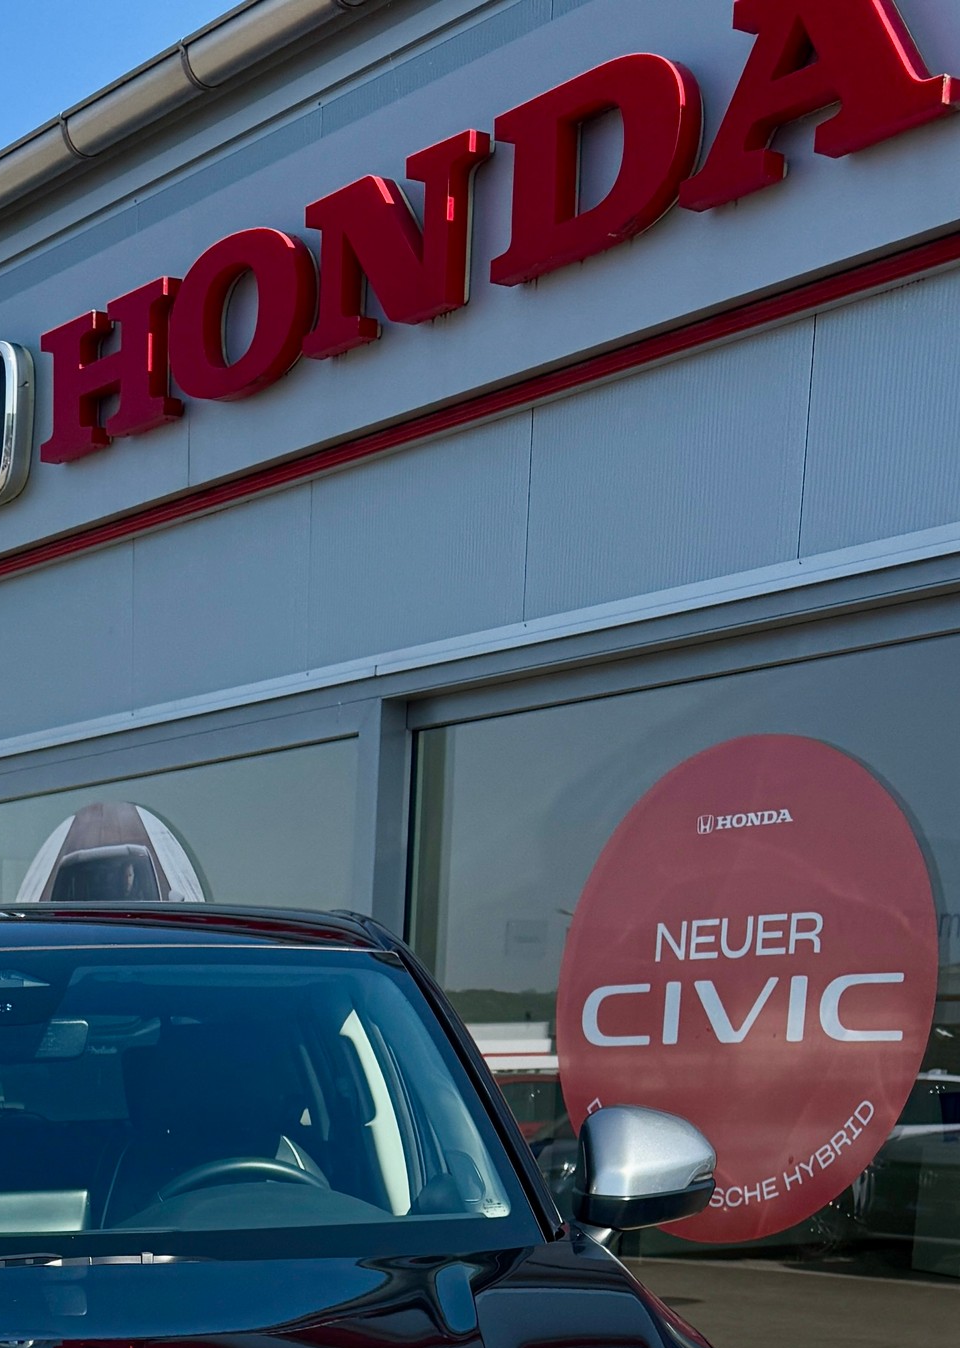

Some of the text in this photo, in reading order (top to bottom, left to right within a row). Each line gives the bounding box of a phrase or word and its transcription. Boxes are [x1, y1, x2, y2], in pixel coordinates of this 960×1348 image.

[41, 0, 960, 463] HONDA
[715, 808, 793, 830] HONDA
[654, 911, 823, 962] NEUER
[581, 972, 905, 1047] CIVIC
[708, 1099, 875, 1208] SCHE HYBRID
